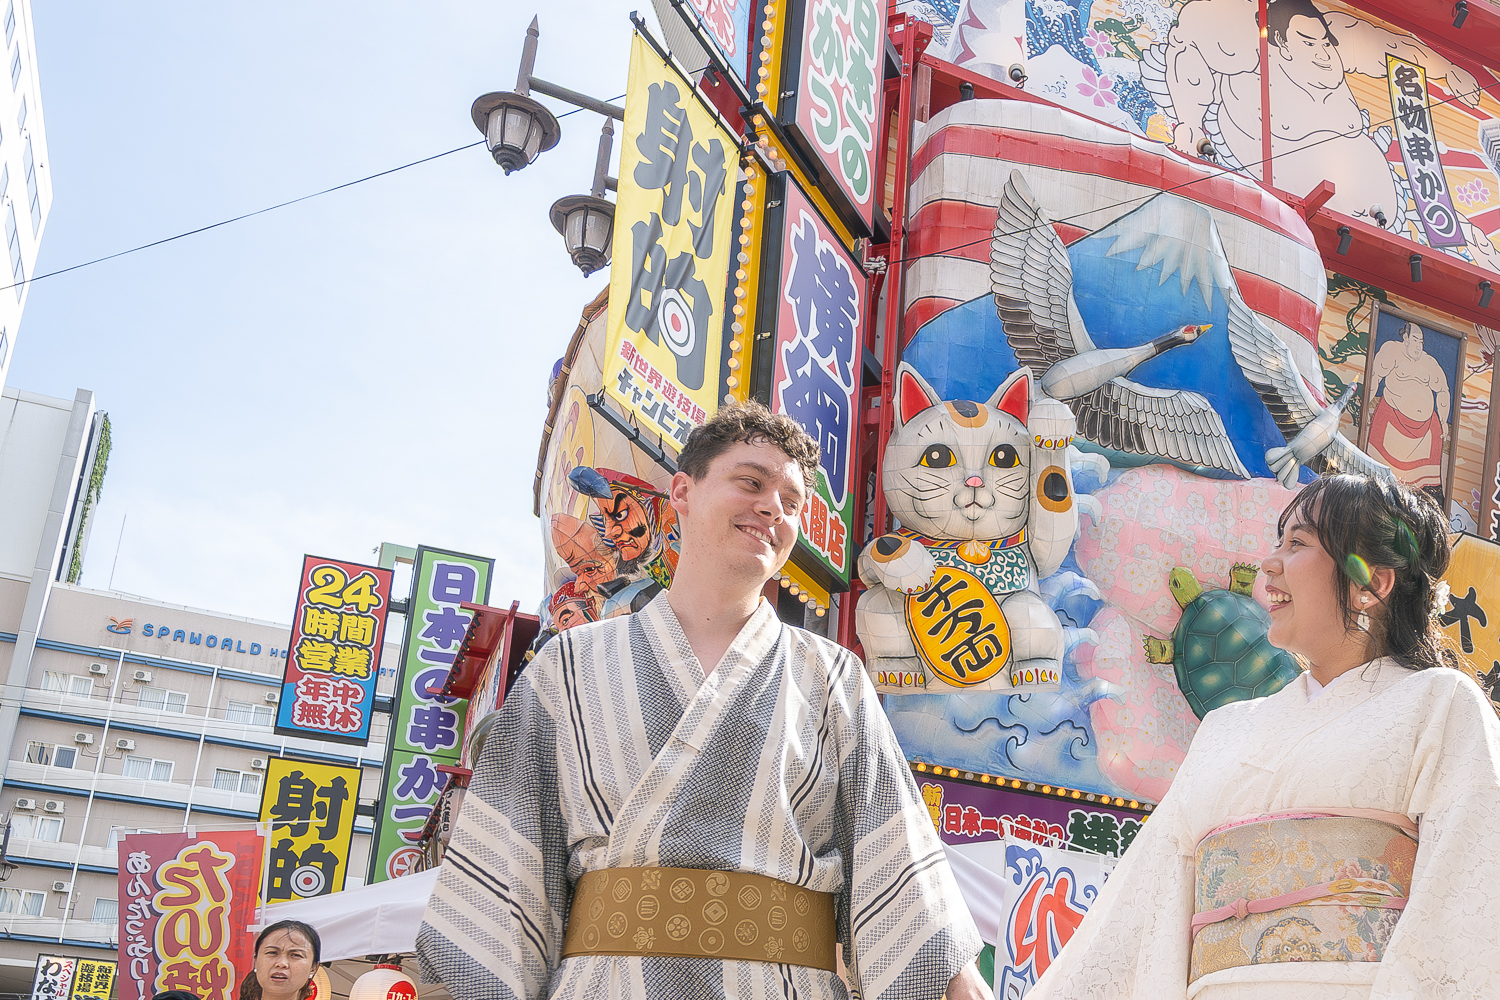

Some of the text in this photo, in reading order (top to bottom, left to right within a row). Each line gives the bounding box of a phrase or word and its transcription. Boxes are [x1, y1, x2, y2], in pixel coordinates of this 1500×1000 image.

[1394, 64, 1457, 238] 名物串かつ
[625, 80, 727, 392] 射的
[620, 339, 707, 426] 新世界遊技場
[784, 219, 859, 505] 横綱
[304, 563, 383, 614] 24
[303, 606, 377, 646] 時間
[297, 638, 372, 679] 営業
[297, 677, 364, 705] 年中
[296, 702, 362, 732] 無休
[258, 770, 349, 902] 射的
[55, 960, 74, 997] スペシャル
